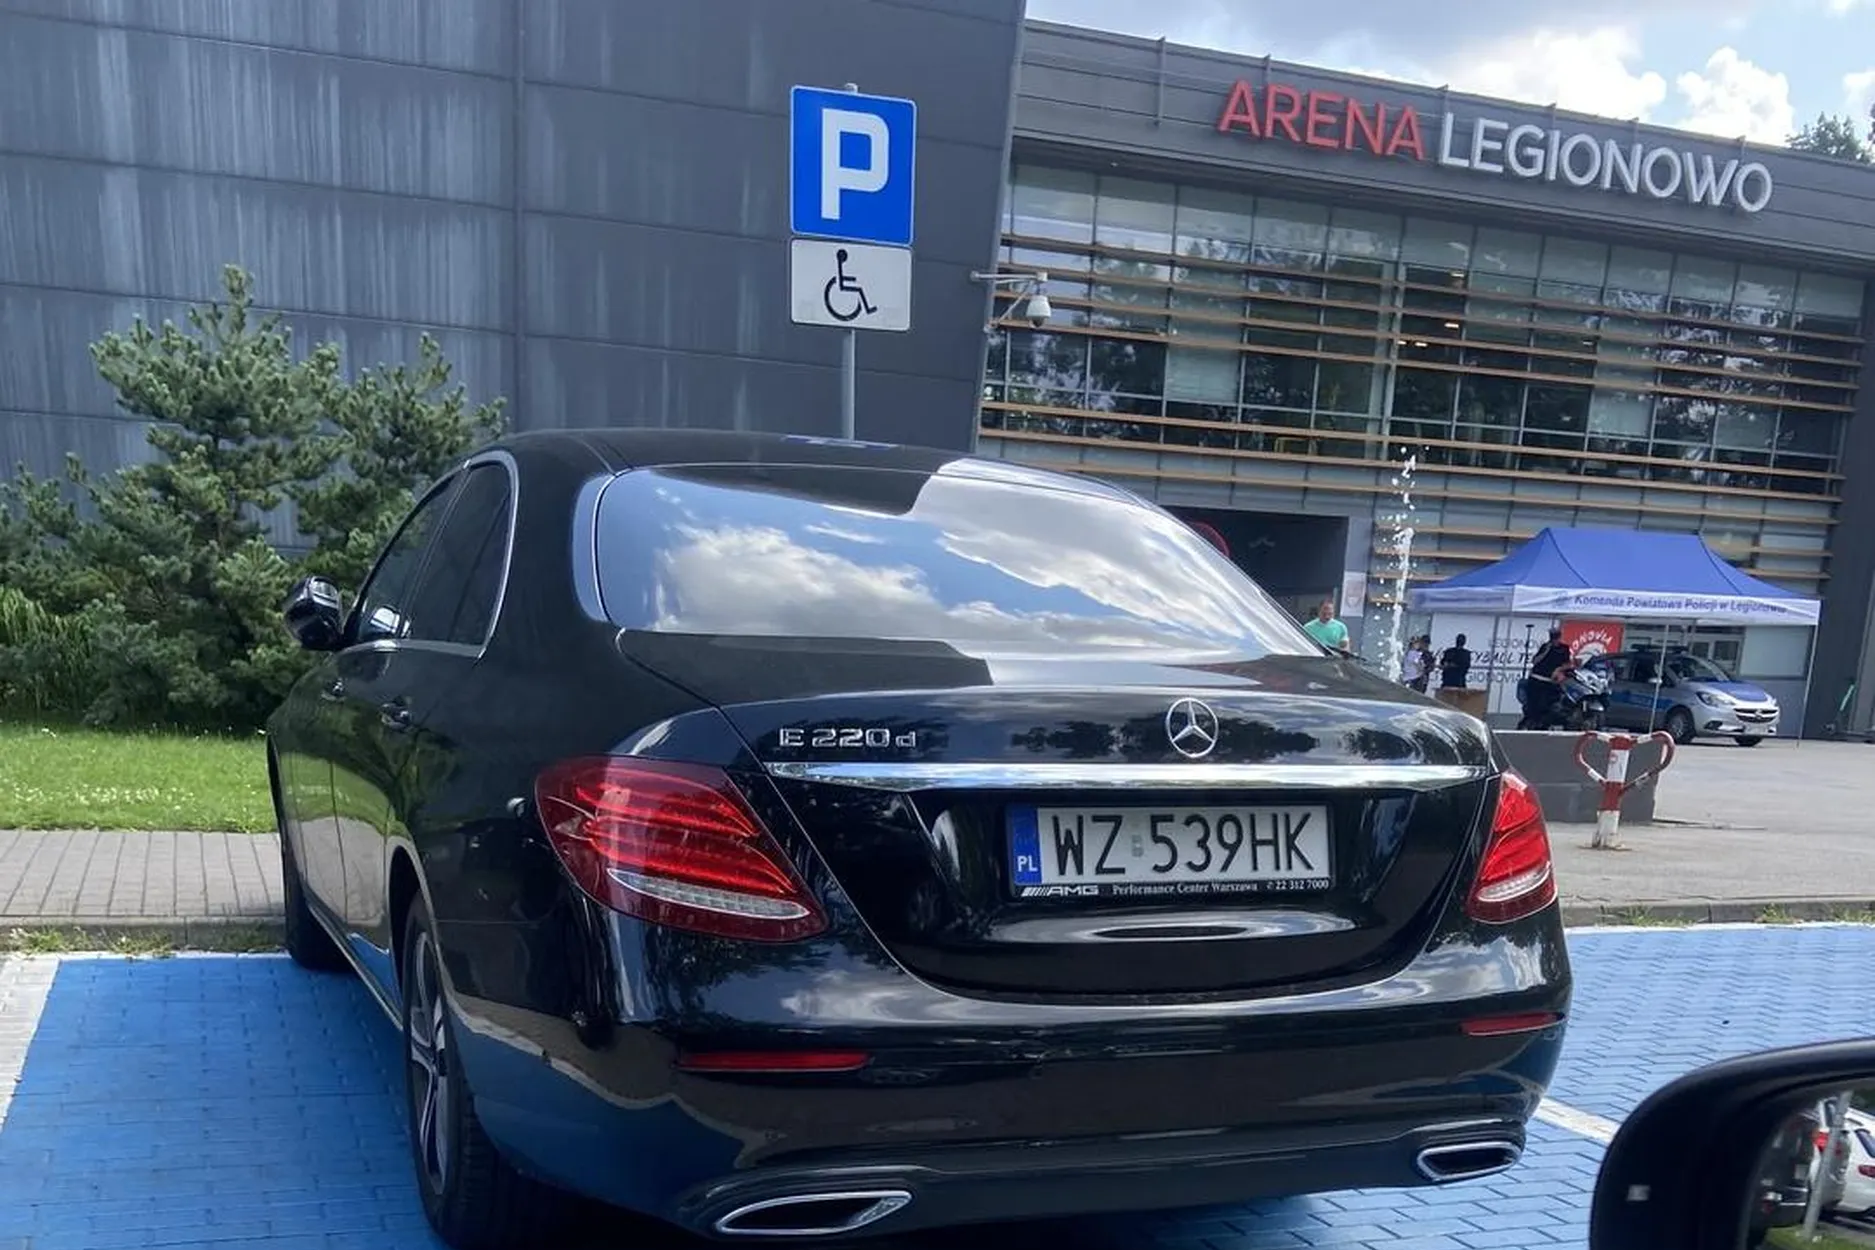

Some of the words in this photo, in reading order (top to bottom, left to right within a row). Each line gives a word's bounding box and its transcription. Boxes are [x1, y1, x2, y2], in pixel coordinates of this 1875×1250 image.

[1218, 79, 1426, 161] ARENA
[1438, 112, 1773, 212] LEGIONOWO
[820, 108, 890, 220] P
[779, 728, 804, 746] E
[812, 728, 890, 747] 220
[895, 731, 916, 747] d
[1052, 814, 1126, 876] WZ
[1150, 813, 1314, 873] 539HK
[1017, 855, 1038, 872] PL
[1050, 885, 1099, 896] AMG
[1112, 884, 1175, 896] Performance
[1177, 882, 1209, 894] Center
[1211, 882, 1259, 893] Warszawa
[1306, 879, 1330, 890] 7000
